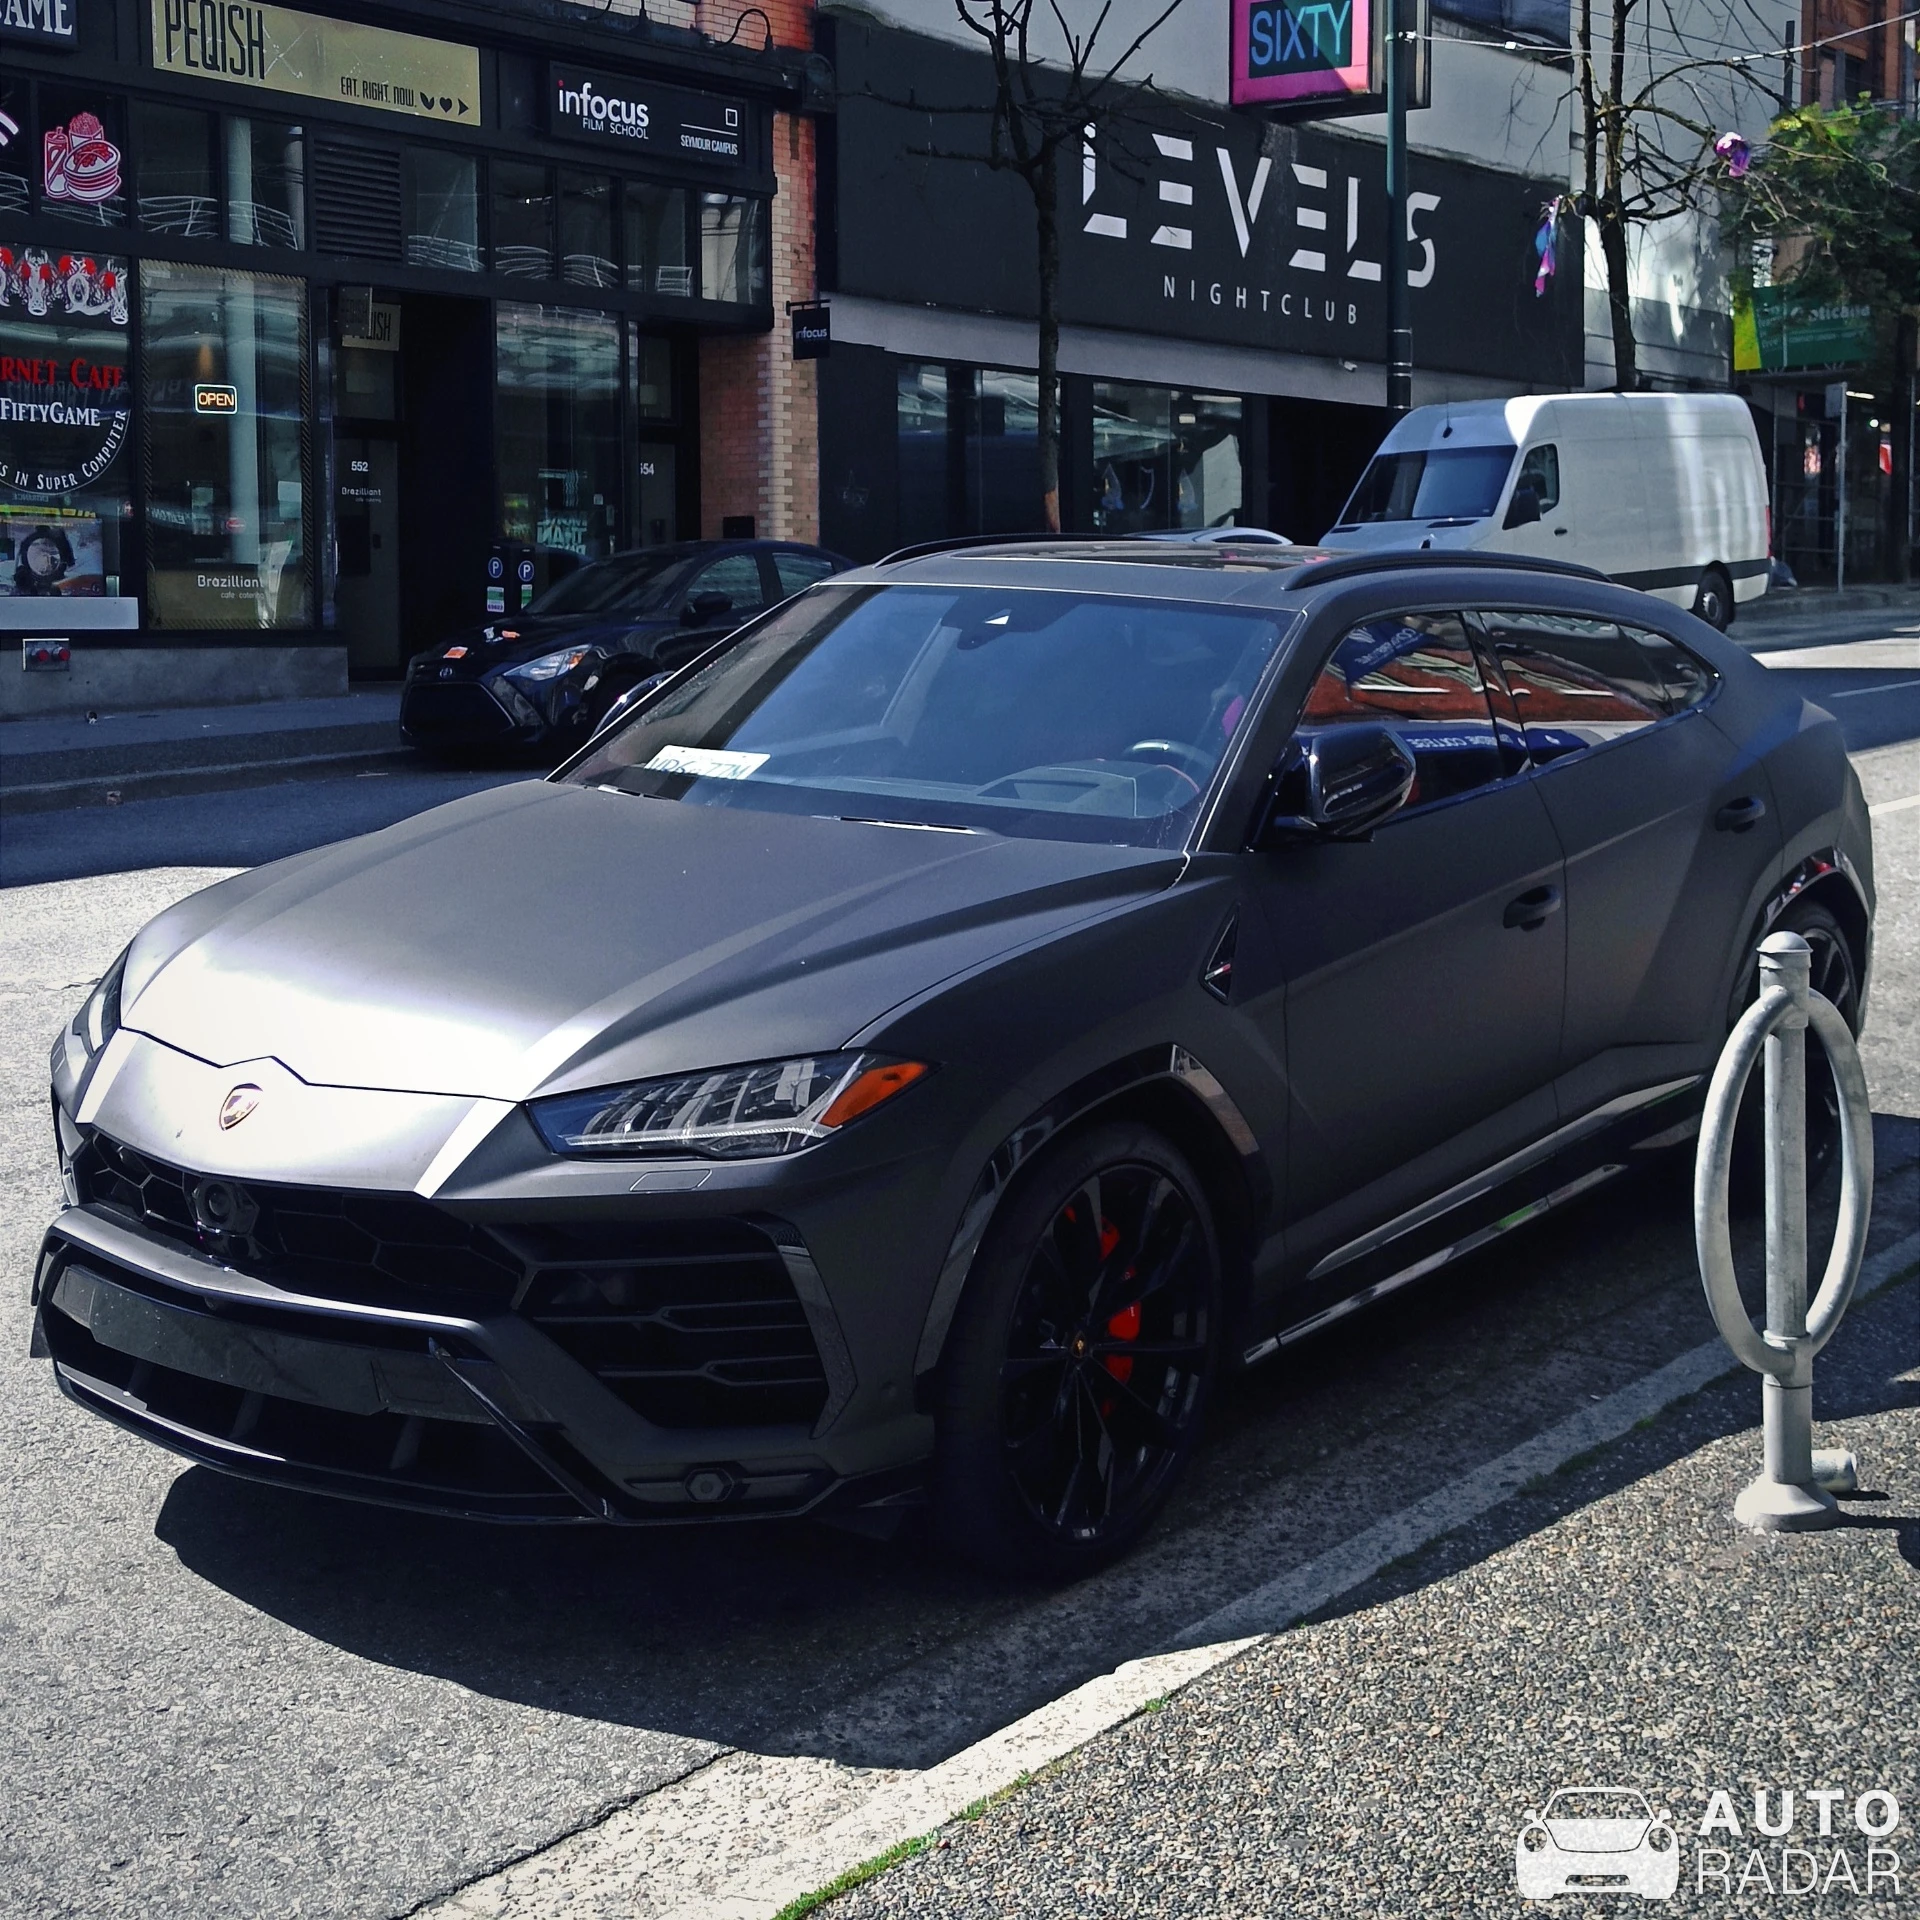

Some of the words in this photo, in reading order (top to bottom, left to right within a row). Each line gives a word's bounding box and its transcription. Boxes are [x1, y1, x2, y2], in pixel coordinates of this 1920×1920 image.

[165, 0, 264, 80] PEQISH
[1251, 0, 1350, 65] SIXTY
[341, 76, 360, 98] EAT.
[362, 80, 391, 103] RIGHT.
[393, 86, 417, 108] NOW.
[558, 79, 649, 127] infocus
[582, 117, 604, 132] FILM
[609, 121, 649, 140] SCHOOL
[681, 134, 710, 151] SEYMOUR
[711, 139, 738, 156] CAMPUS
[1083, 121, 1441, 288] LEVELS
[1163, 274, 1357, 325] NIGHTCLUB
[198, 392, 235, 406] OPEN
[15, 471, 29, 487] IN
[37, 473, 78, 490] SUPER
[82, 410, 127, 478] COMPUTER
[351, 460, 369, 472] 552
[197, 575, 264, 588] Brazilliant
